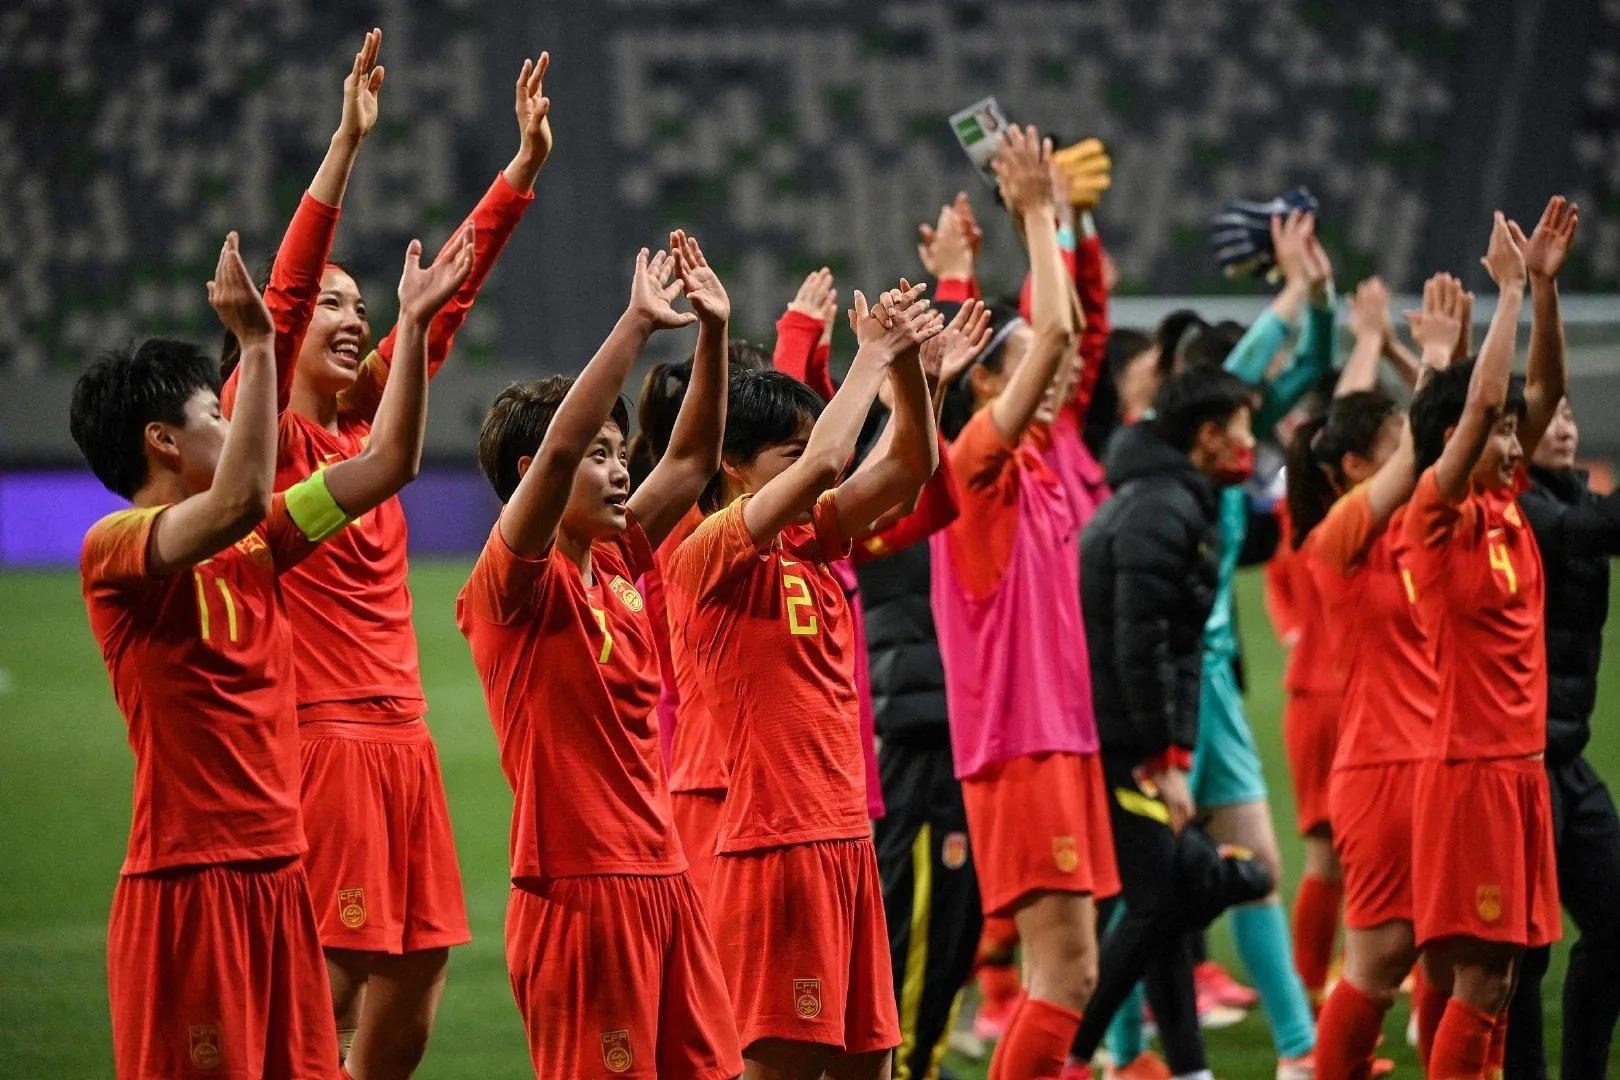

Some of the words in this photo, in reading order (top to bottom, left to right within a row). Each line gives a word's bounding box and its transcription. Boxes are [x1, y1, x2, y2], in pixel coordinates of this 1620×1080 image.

[1488, 542, 1517, 594] 4
[194, 572, 238, 642] 11
[783, 574, 818, 634] 2
[590, 607, 613, 663] 7
[339, 890, 362, 900] CFA
[795, 981, 818, 990] CFA
[603, 1032, 627, 1043] CFA
